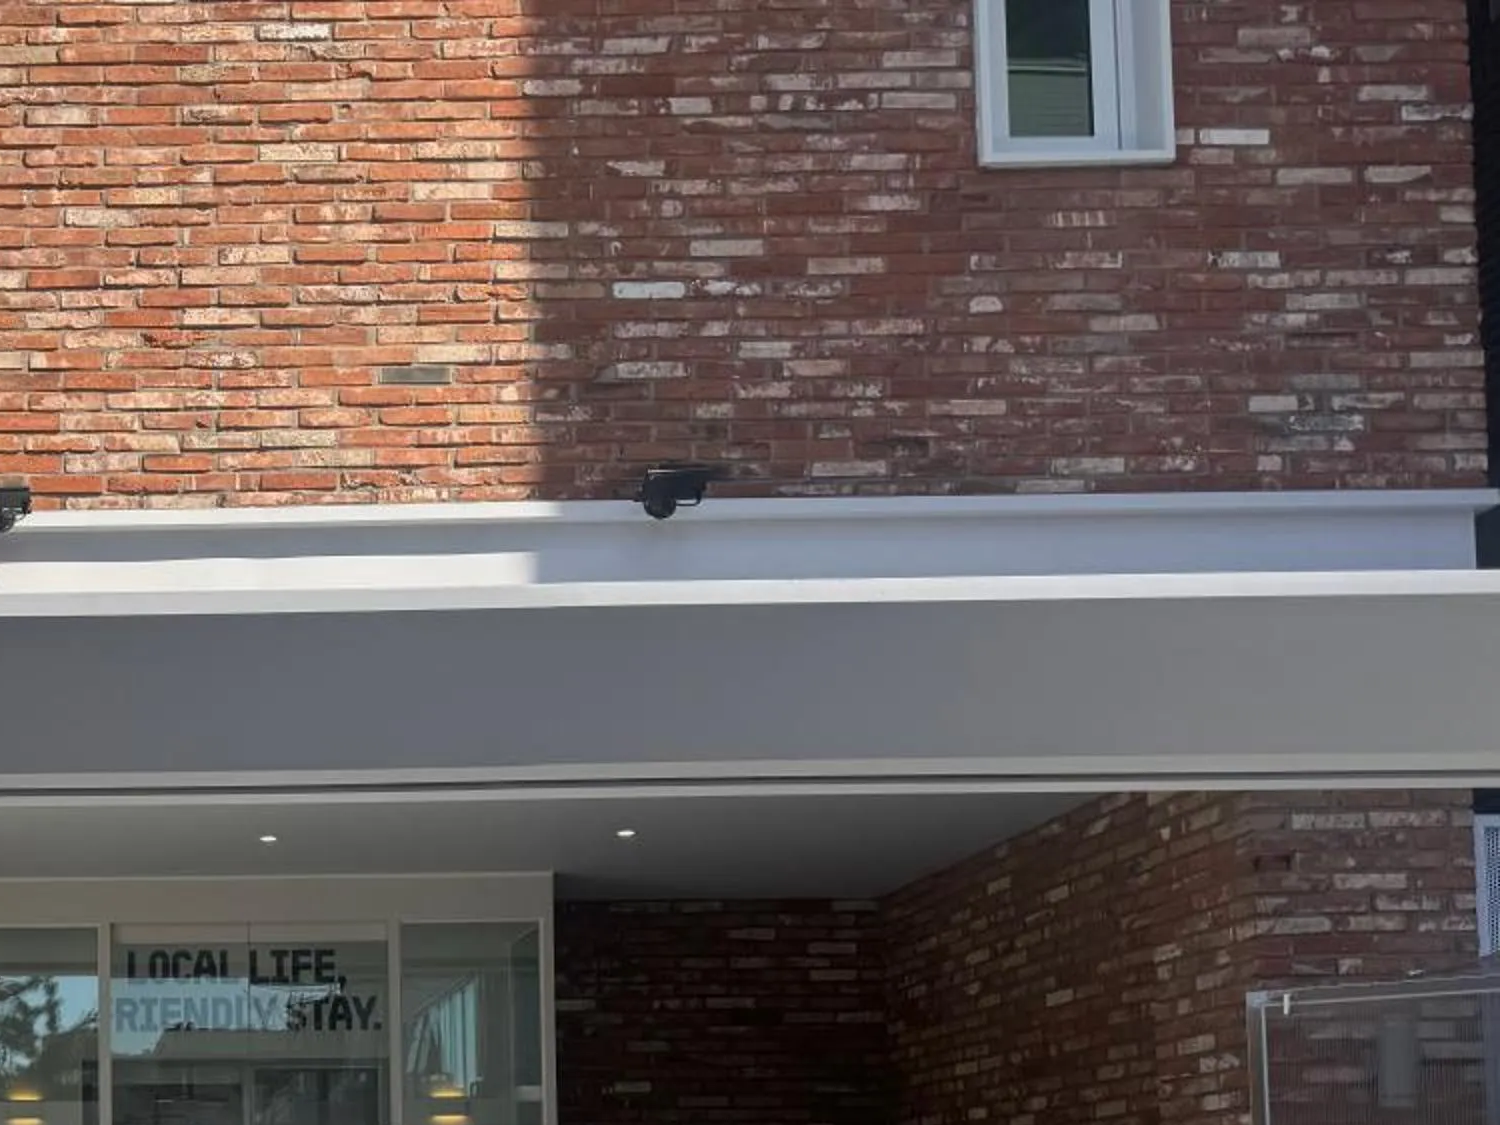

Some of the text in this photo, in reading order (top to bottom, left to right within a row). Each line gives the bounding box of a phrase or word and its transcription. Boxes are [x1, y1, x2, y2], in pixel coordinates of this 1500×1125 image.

[126, 948, 347, 993] LOCAL LIFE,
[114, 995, 384, 1033] RIENDLY STAY.
